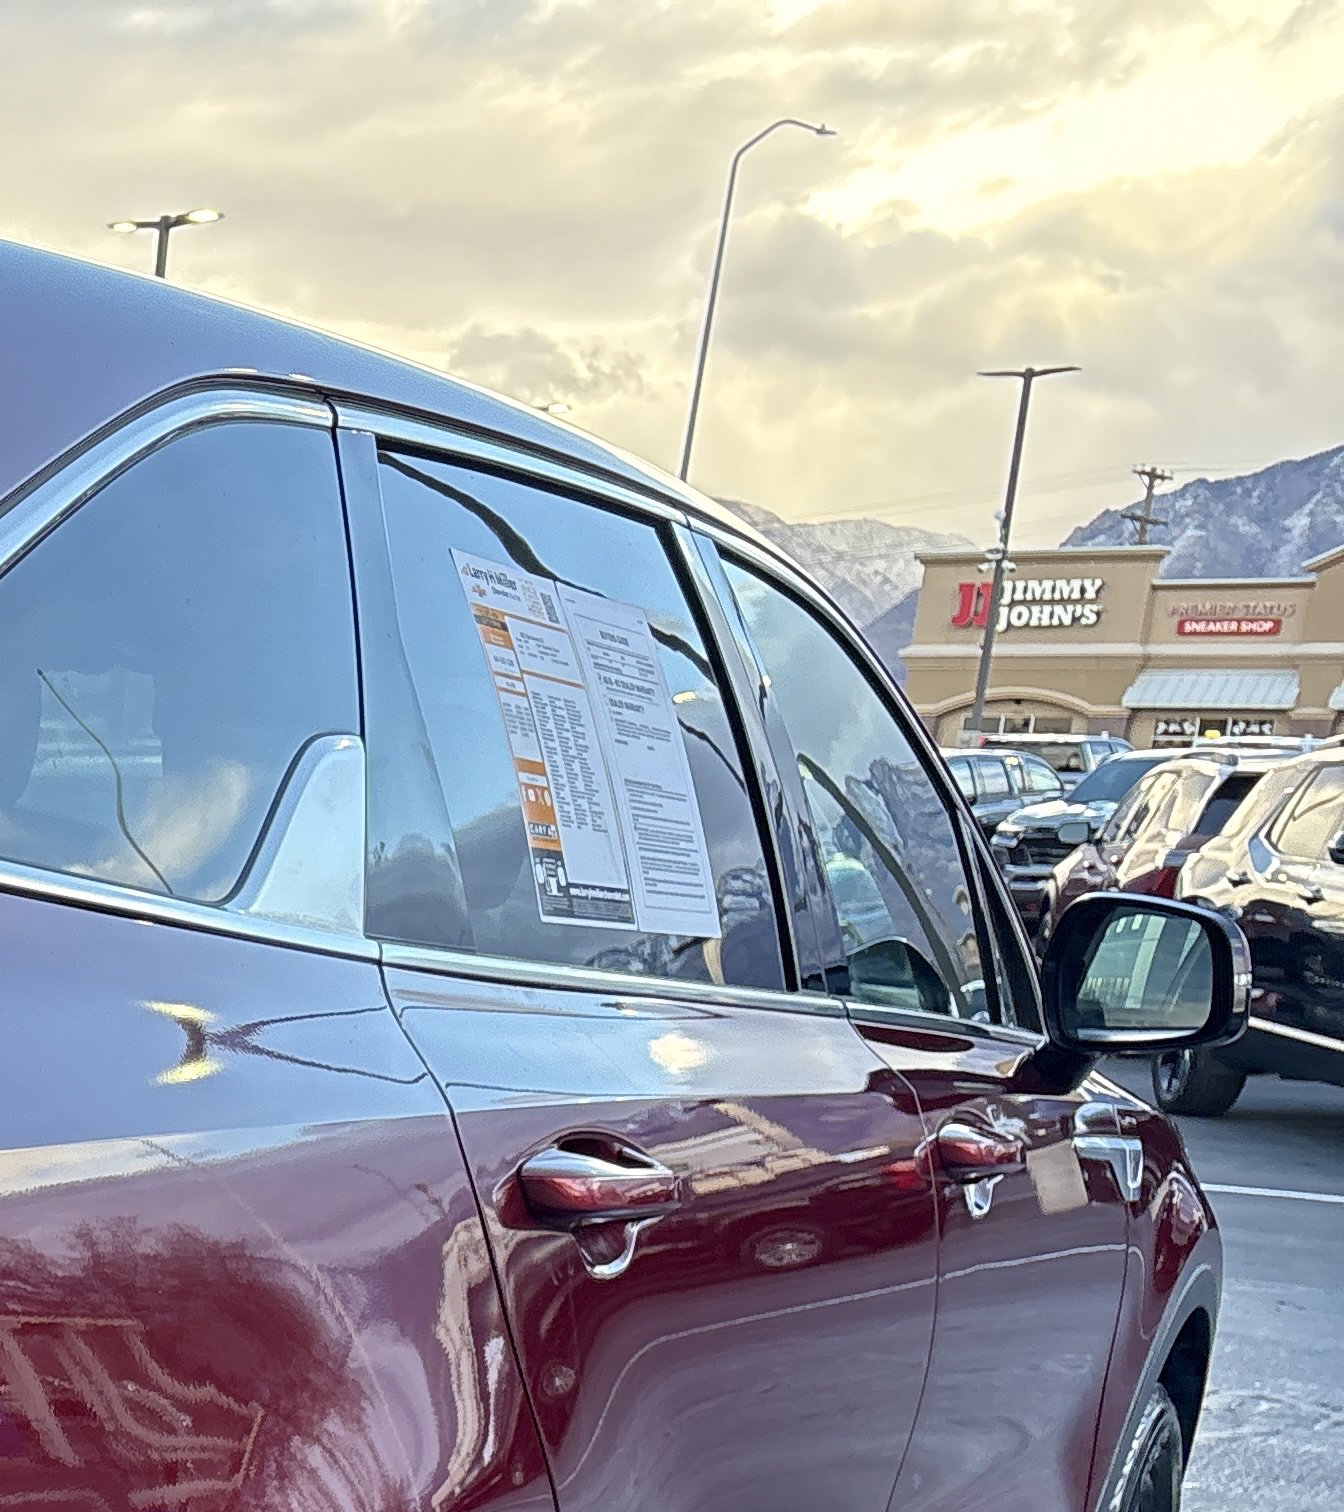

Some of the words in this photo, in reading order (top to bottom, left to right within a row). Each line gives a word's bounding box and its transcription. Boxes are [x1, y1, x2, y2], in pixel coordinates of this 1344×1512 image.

[999, 578, 1103, 606] JIMMY
[994, 603, 1101, 633] JOHN'S
[1183, 620, 1238, 633] SNEAKER
[1238, 620, 1274, 633] SHOP
